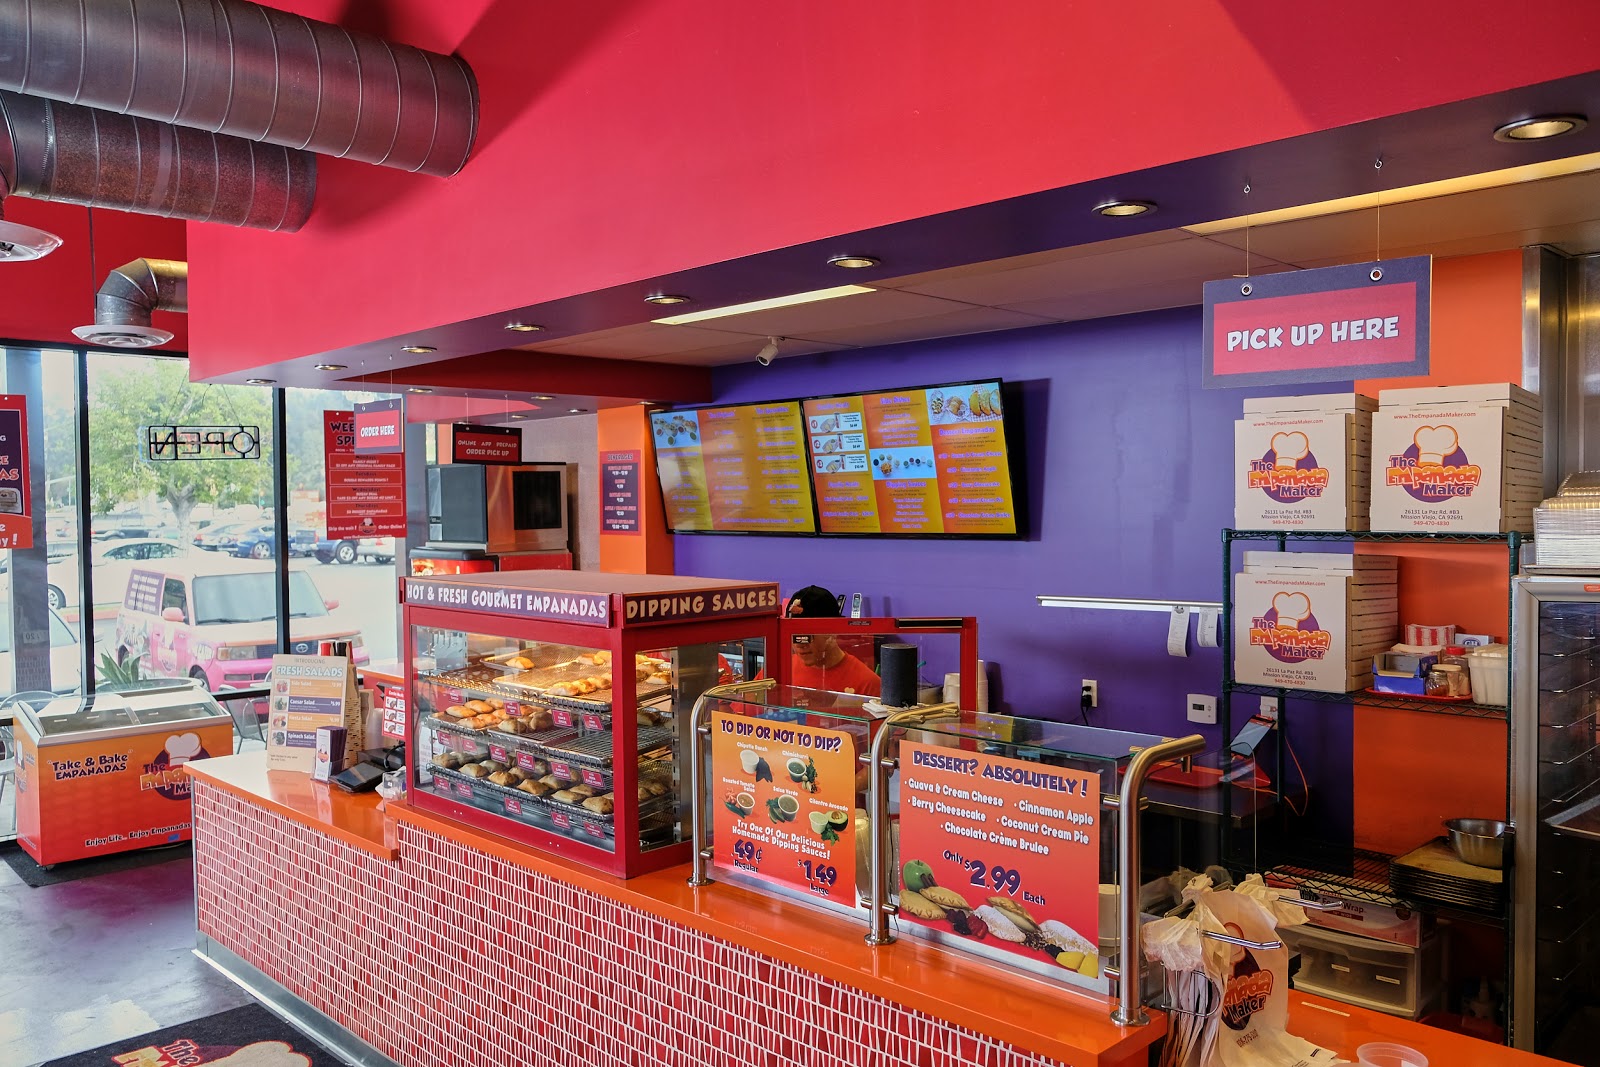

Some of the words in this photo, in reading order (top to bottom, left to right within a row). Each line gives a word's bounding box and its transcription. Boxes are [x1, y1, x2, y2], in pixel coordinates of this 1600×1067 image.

[1227, 327, 1284, 352] PICK
[1290, 324, 1323, 347] UP
[1331, 316, 1399, 343] HERE
[361, 426, 379, 437] ORDER
[380, 425, 394, 435] HERE
[1251, 460, 1273, 471] The
[1390, 455, 1416, 467] The
[1280, 485, 1323, 497] Maker
[1423, 483, 1473, 496] Maker
[406, 584, 424, 600] HOT
[427, 586, 434, 600] &
[438, 588, 468, 604] FRESH
[471, 590, 522, 610] GOURMET
[527, 595, 606, 618] EMPANADAS
[626, 596, 705, 619] DIPPING
[712, 590, 776, 612] SAUCES
[1252, 617, 1275, 629] The
[1281, 645, 1324, 660] Maker
[276, 665, 303, 675] FRESH
[304, 667, 343, 677] SALADS
[721, 720, 734, 733] TO
[736, 722, 753, 737] DIP
[756, 726, 770, 740] OR
[774, 729, 795, 744] NOT
[798, 733, 812, 748] TO
[814, 735, 842, 753] DIP?
[737, 742, 754, 750] Chipotle
[755, 744, 768, 752] Ranch
[85, 757, 95, 767] &
[782, 750, 809, 760] Chimichurri
[55, 763, 127, 781] EMPANADAS
[143, 762, 166, 774] The
[912, 750, 979, 777] DESSERT?
[981, 764, 1077, 794] ABSOLUTELY
[1080, 778, 1088, 797] !
[722, 777, 739, 785] Roasted
[739, 780, 755, 788] Tomato
[773, 786, 785, 794] Salsa
[786, 788, 798, 796] Verde
[809, 798, 828, 807] Cilantro
[829, 802, 848, 812] Avocado
[908, 778, 934, 793] Guava
[935, 783, 941, 794] &
[942, 784, 970, 800] Cream
[972, 790, 1004, 807] Cheese
[1019, 800, 1065, 820] Cinnamon
[1066, 809, 1094, 826] Apple
[912, 796, 934, 813] Berry
[935, 800, 986, 822] Cheesecake
[1001, 816, 1039, 834] Coconut
[1041, 824, 1072, 841] Cream
[1074, 830, 1090, 845] Pie
[85, 838, 107, 847] Enjoy
[129, 831, 150, 839] Enjoy
[151, 822, 192, 834] Empanadas
[737, 820, 748, 830] Try
[750, 823, 763, 833] One
[765, 827, 774, 835] Of
[776, 830, 788, 840] Our
[791, 833, 824, 849] Delicious
[945, 822, 987, 841] Chocolate
[989, 832, 1017, 848] Crème
[1020, 838, 1049, 855] Brulee
[732, 826, 769, 843] Homemade
[772, 836, 799, 853] Dipping
[802, 845, 830, 860] Sauces!
[733, 859, 758, 873] Regular
[797, 859, 837, 887] $1.49
[943, 850, 964, 865] Only
[964, 859, 1021, 897] $2.99
[1022, 891, 1046, 905] Each
[810, 883, 829, 896] Large
[1344, 903, 1364, 913] Wrap
[1227, 995, 1266, 1022] Maker
[162, 1040, 200, 1066] The
